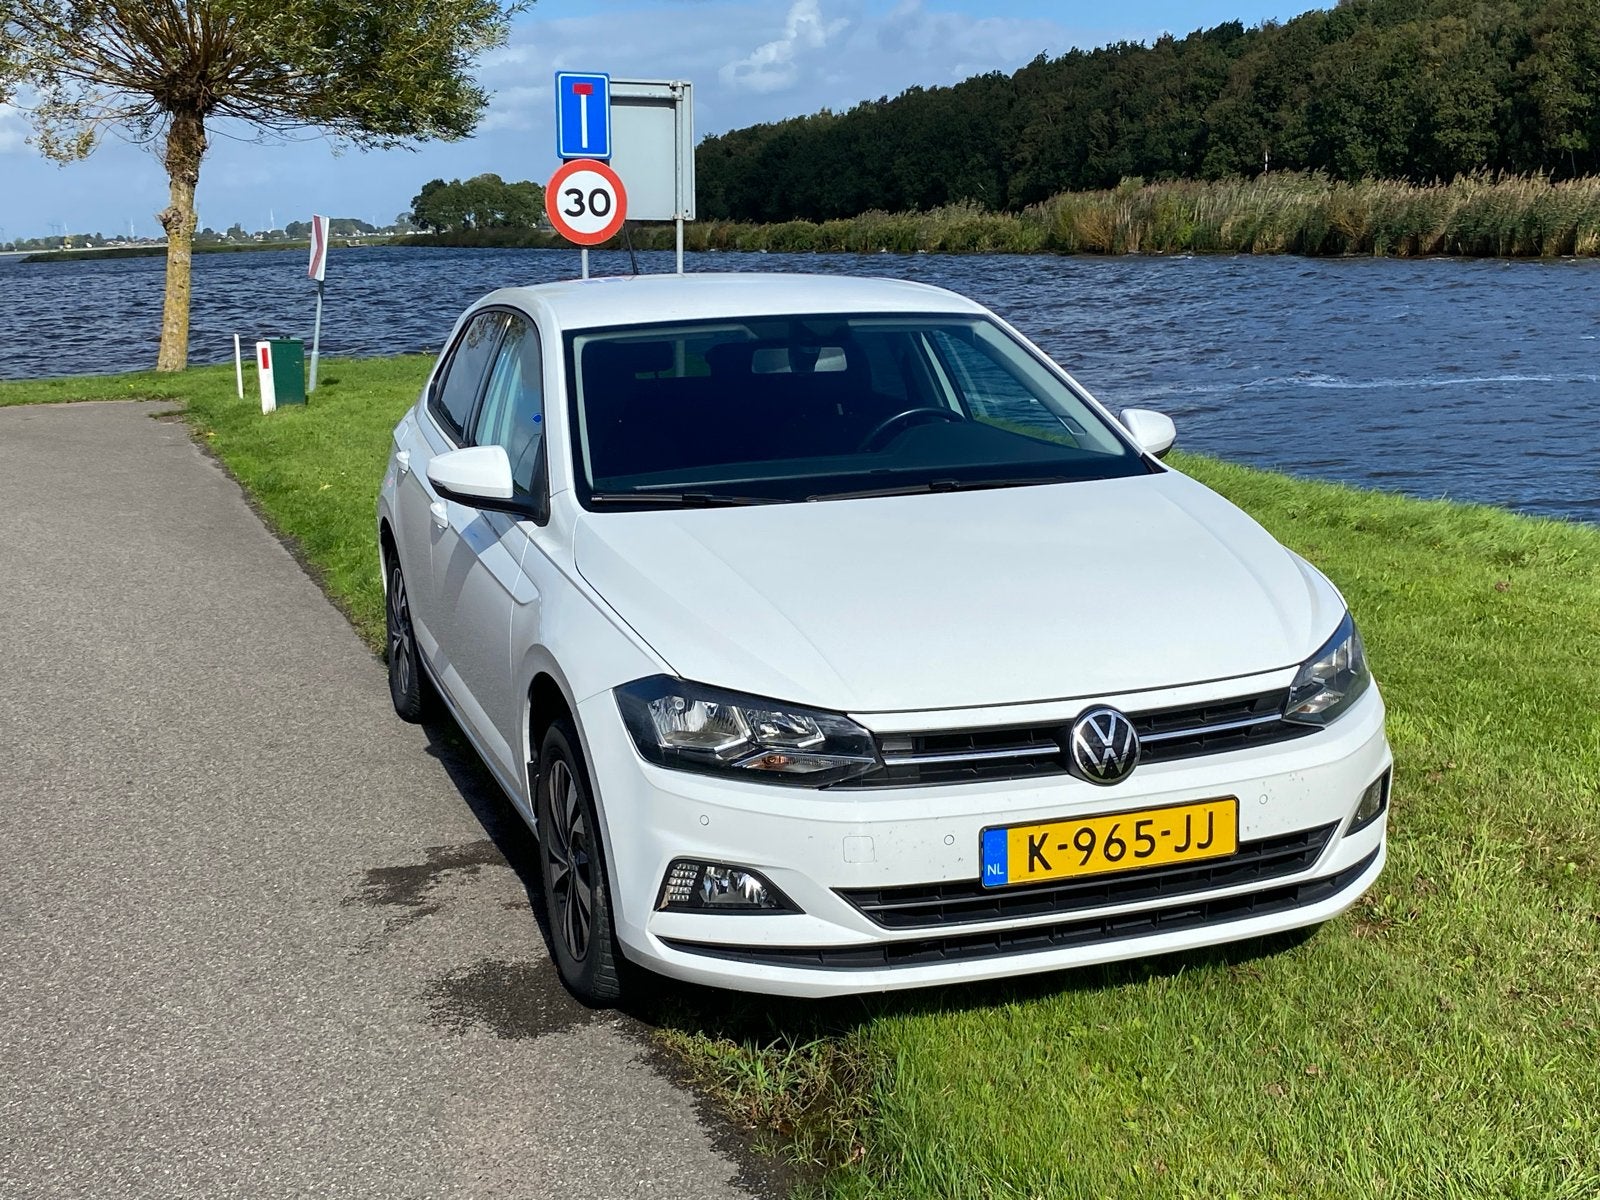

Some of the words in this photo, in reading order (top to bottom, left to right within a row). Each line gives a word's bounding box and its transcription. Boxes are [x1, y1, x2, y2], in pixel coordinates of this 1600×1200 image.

[564, 188, 611, 217] 30
[1073, 709, 1137, 780] VW
[1028, 811, 1214, 873] K-965-JJ
[987, 862, 1005, 877] NL
